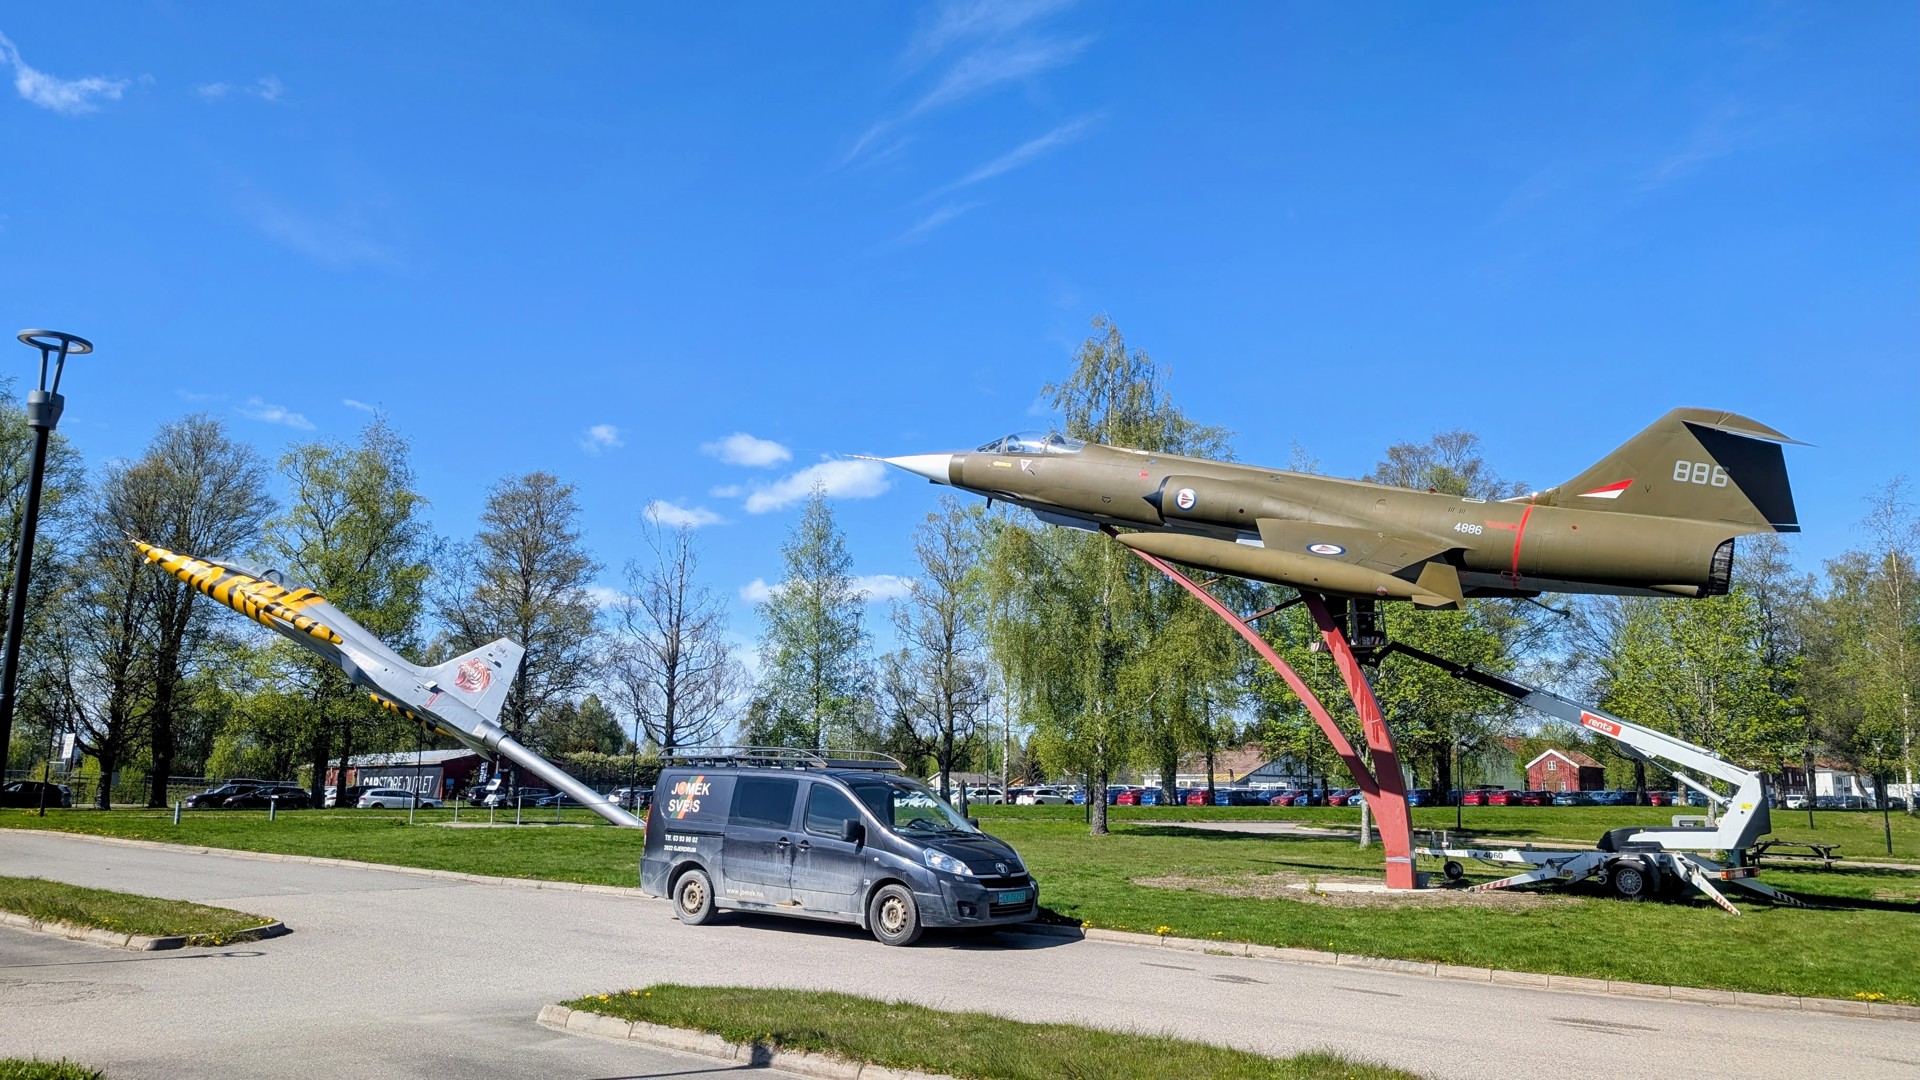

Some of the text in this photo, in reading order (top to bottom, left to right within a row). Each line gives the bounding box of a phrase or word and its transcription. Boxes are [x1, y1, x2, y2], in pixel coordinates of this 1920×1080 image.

[1673, 460, 1729, 487] 886
[1454, 522, 1483, 535] 4886
[1588, 718, 1613, 731] renta
[403, 775, 434, 794] OUTLET
[671, 781, 711, 796] JOMEK
[668, 799, 701, 813] SVEIS
[1484, 851, 1503, 860] 4060
